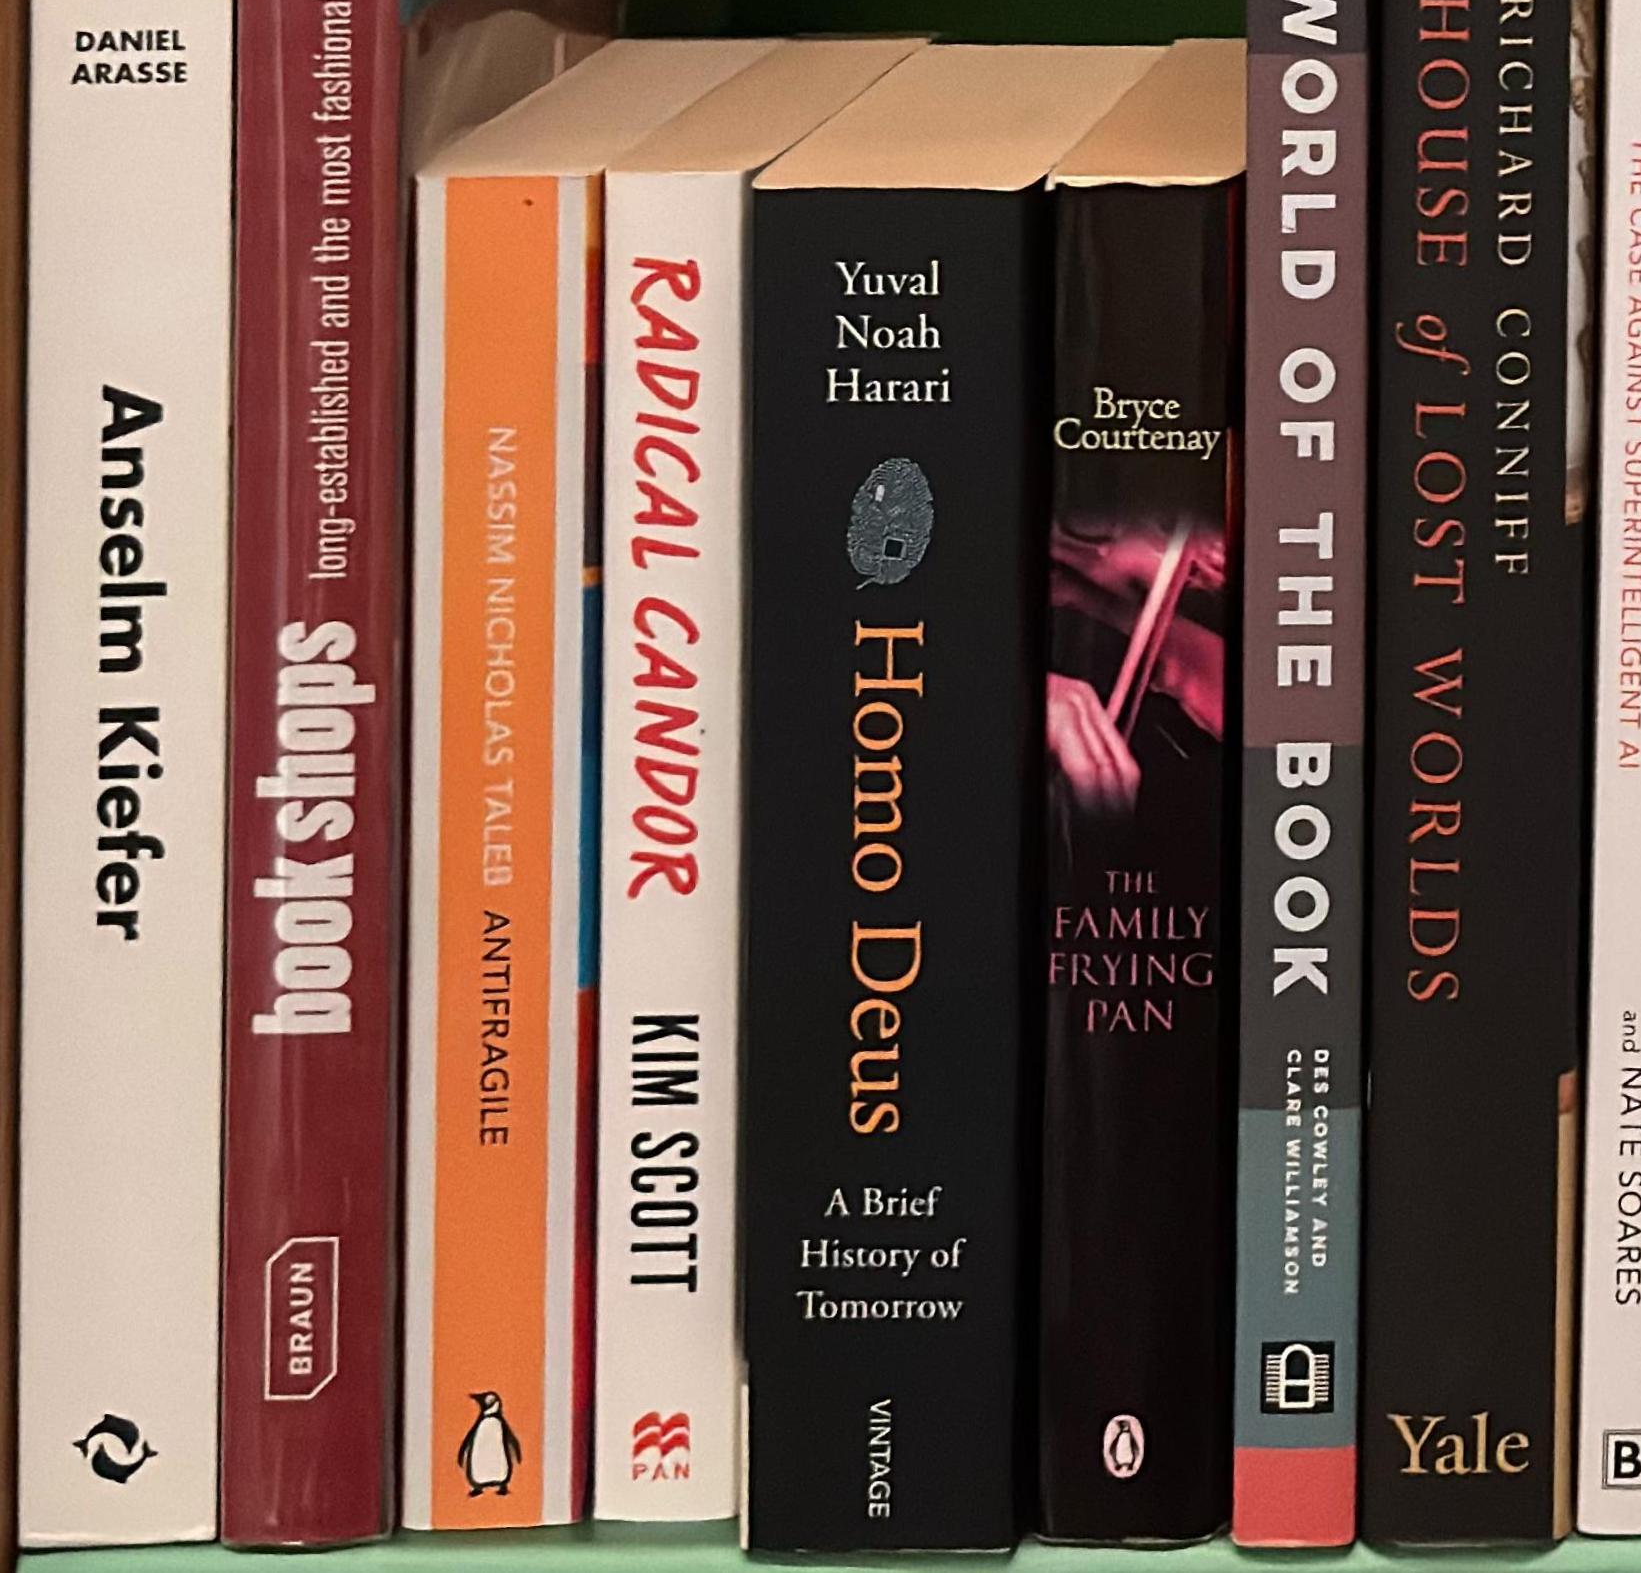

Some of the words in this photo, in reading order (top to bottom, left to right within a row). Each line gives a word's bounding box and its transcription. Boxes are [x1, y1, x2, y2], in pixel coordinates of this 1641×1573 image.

[70, 61, 188, 84] ARASSE
[74, 30, 186, 51] DANIEL
[320, 134, 352, 203] most
[313, 215, 351, 267] the
[834, 259, 941, 297] Yuval
[310, 274, 351, 329] and
[836, 313, 942, 350] Noah
[825, 368, 951, 404] Harari
[1396, 314, 1471, 377] of
[630, 257, 700, 571] RADICAL
[1053, 418, 1221, 460] Courtenay
[1092, 388, 1181, 430] Bryce
[1279, 347, 1335, 460] OF
[1494, 307, 1531, 575] CONNIFF
[309, 338, 356, 580] long-established
[487, 428, 517, 564] NASSIM
[97, 385, 169, 674] Anselm
[1412, 402, 1467, 605] LOST
[1278, 513, 1333, 687] THE
[484, 577, 517, 766] NICHOLAS
[255, 620, 376, 840] shops
[627, 596, 700, 898] CANDOR
[853, 619, 925, 892] Homo
[1617, 741, 1640, 769] AI
[95, 708, 165, 941] Kiefer
[482, 778, 514, 887] TALEB
[1408, 648, 1464, 1002] WORLDS
[1105, 870, 1160, 894] THE
[1273, 742, 1331, 995] BOOK
[253, 855, 354, 1034] book
[1054, 906, 1211, 940] FAMILY
[1048, 952, 1216, 987] FRYING
[478, 910, 511, 1147] ANTIFRAGILE
[849, 920, 922, 1135] Deus
[1087, 1000, 1174, 1033] PAN
[1622, 1010, 1638, 1054] and
[629, 1013, 700, 1108] KIM
[1287, 1050, 1302, 1127] CLARE
[1314, 1050, 1329, 1097] DES
[1313, 1104, 1329, 1207] COWLEY
[629, 1131, 700, 1293] SCOTT
[825, 1187, 850, 1217] A
[862, 1184, 943, 1217] Brief
[1284, 1139, 1302, 1294] WILLIAMSON
[1311, 1218, 1327, 1267] AND
[800, 1238, 920, 1276] History
[930, 1237, 967, 1268] of
[288, 1262, 314, 1377] BRAUN
[796, 1290, 964, 1321] Tomorrow
[632, 1462, 691, 1481] PAN
[867, 1398, 891, 1518] VINTAGE
[1387, 1412, 1530, 1474] Yale
